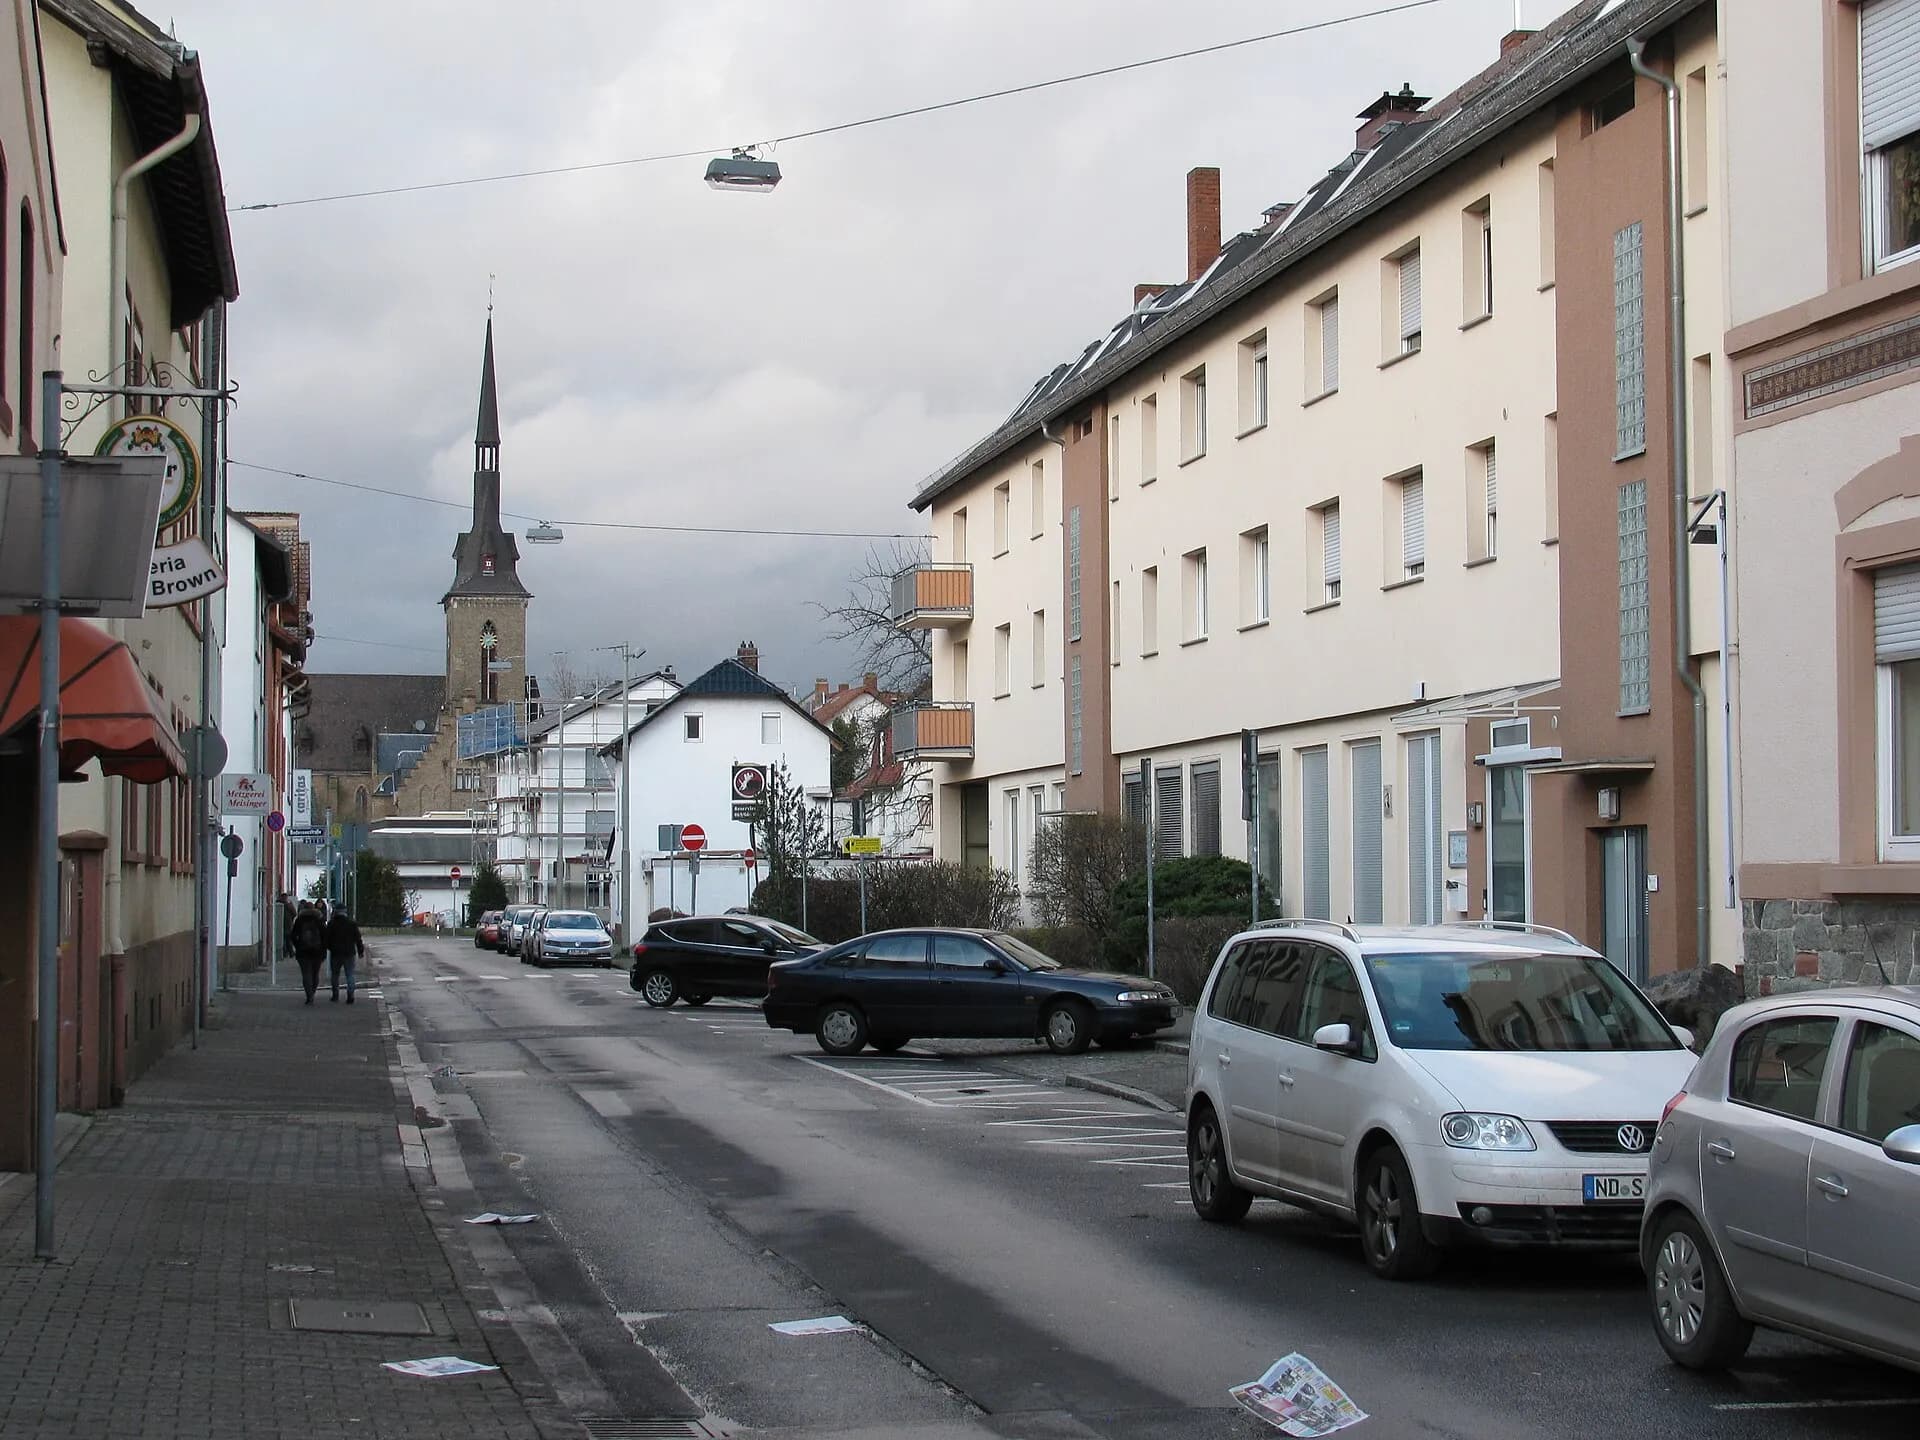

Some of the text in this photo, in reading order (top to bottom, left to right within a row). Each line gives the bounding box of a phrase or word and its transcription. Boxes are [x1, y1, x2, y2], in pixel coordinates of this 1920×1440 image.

[152, 567, 217, 597] Brown
[226, 789, 265, 799] Metzgerei
[294, 775, 306, 814] caritas
[228, 799, 267, 809] Meisinger
[1595, 1178, 1643, 1197] ND S
